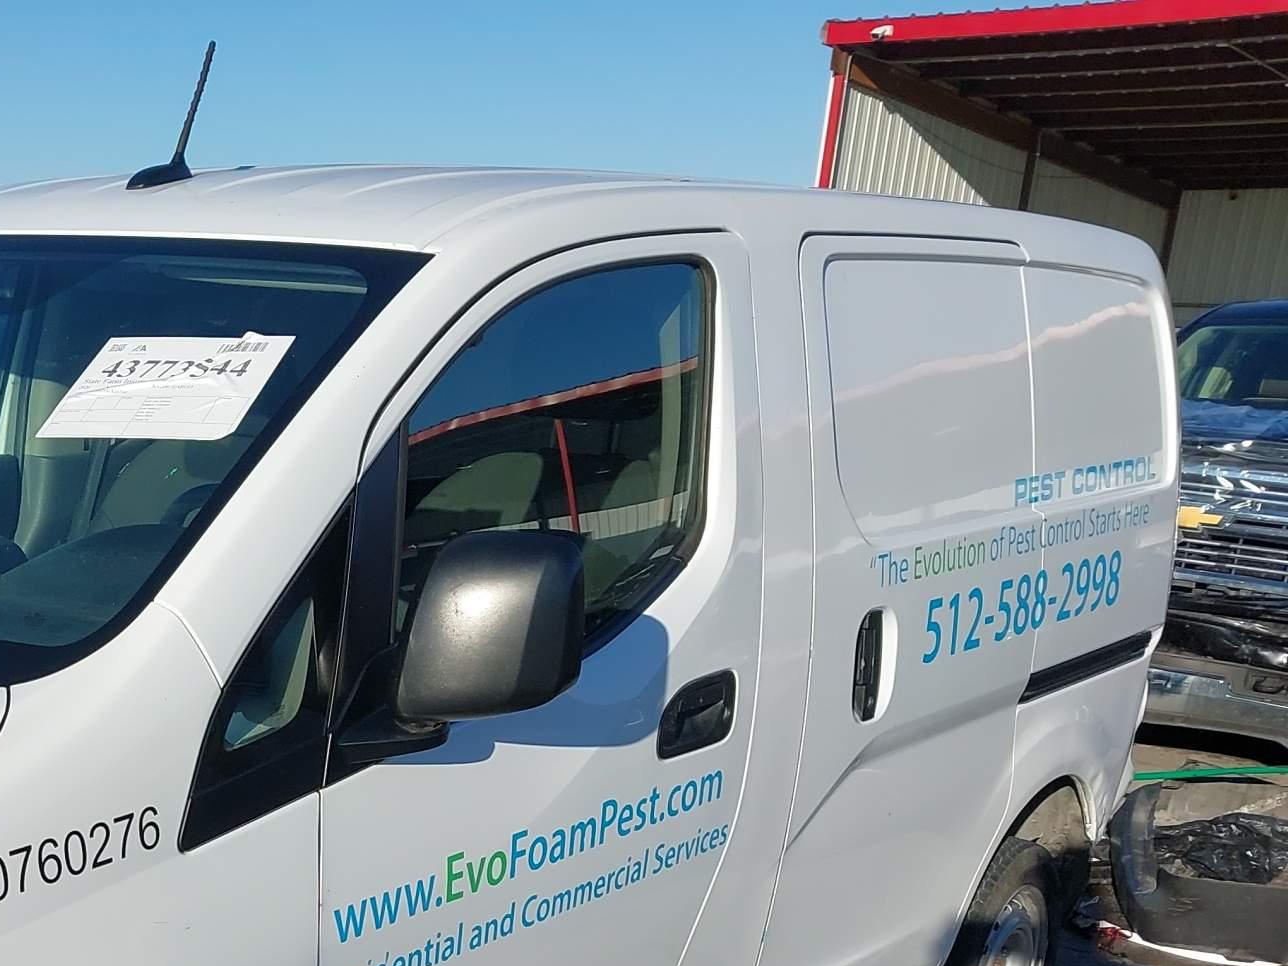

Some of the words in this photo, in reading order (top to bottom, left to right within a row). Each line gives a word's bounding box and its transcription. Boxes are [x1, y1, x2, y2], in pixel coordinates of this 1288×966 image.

[1015, 471, 1066, 507] PEST
[1072, 456, 1156, 495] CONTROL
[913, 536, 985, 580] Evolution
[990, 526, 1006, 561] of
[1008, 524, 1036, 556] Pest
[1040, 508, 1086, 549] Control
[1088, 508, 1122, 537] Starts
[1124, 500, 1150, 528] Here
[922, 551, 1122, 664] 512-588-2998
[334, 770, 724, 943] www.EvoFoamPest.com
[469, 902, 515, 950] and
[521, 848, 650, 928] Commercial
[652, 824, 729, 875] Services
